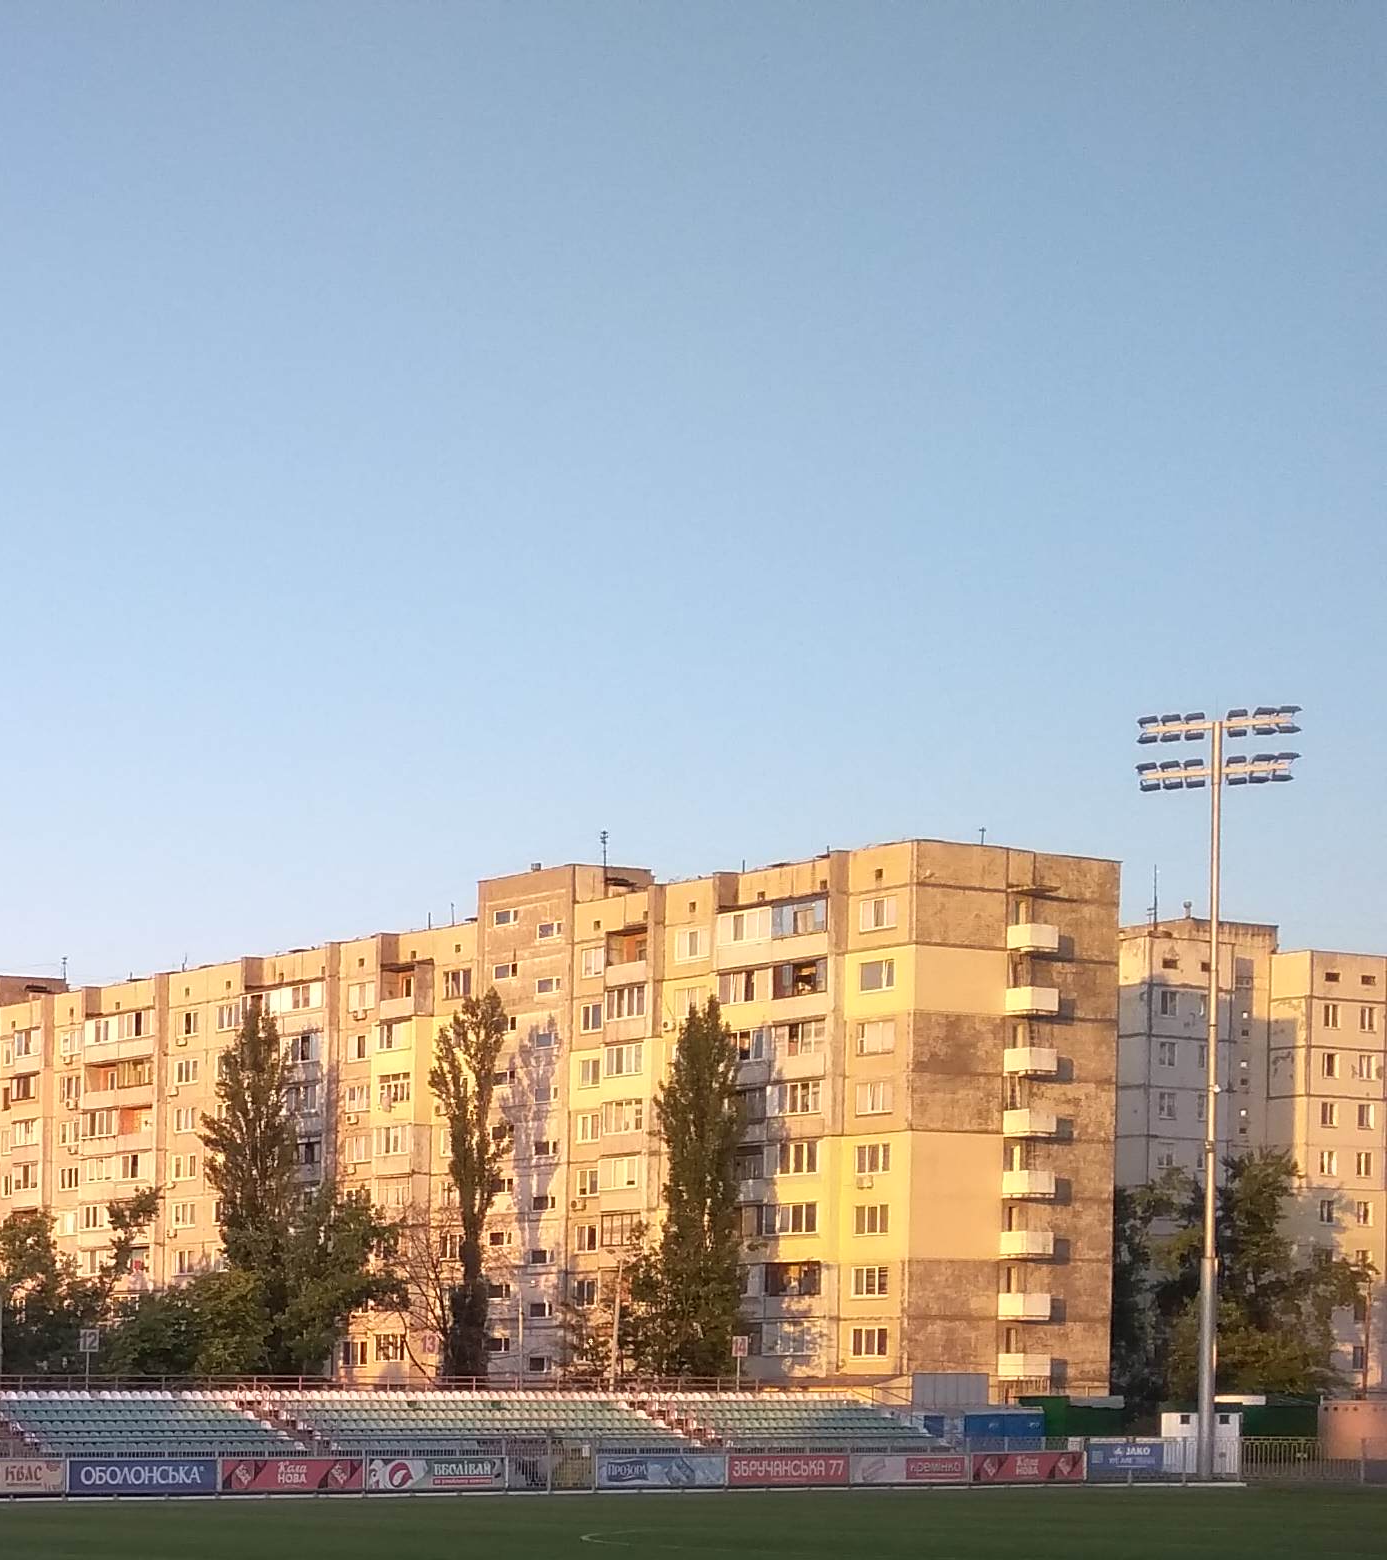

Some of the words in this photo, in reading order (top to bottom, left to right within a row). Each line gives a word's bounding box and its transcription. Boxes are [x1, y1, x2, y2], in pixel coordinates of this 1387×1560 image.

[82, 1331, 97, 1349] 12
[421, 1334, 436, 1353] 13
[1126, 1447, 1150, 1456] JAKO
[5, 1465, 43, 1481] КВАС
[80, 1466, 202, 1484] ОБОЛОНСЬКА
[732, 1460, 825, 1477] ЗБРУЧАНСЬКА
[829, 1460, 844, 1476] 77
[278, 1474, 307, 1484] НОВА
